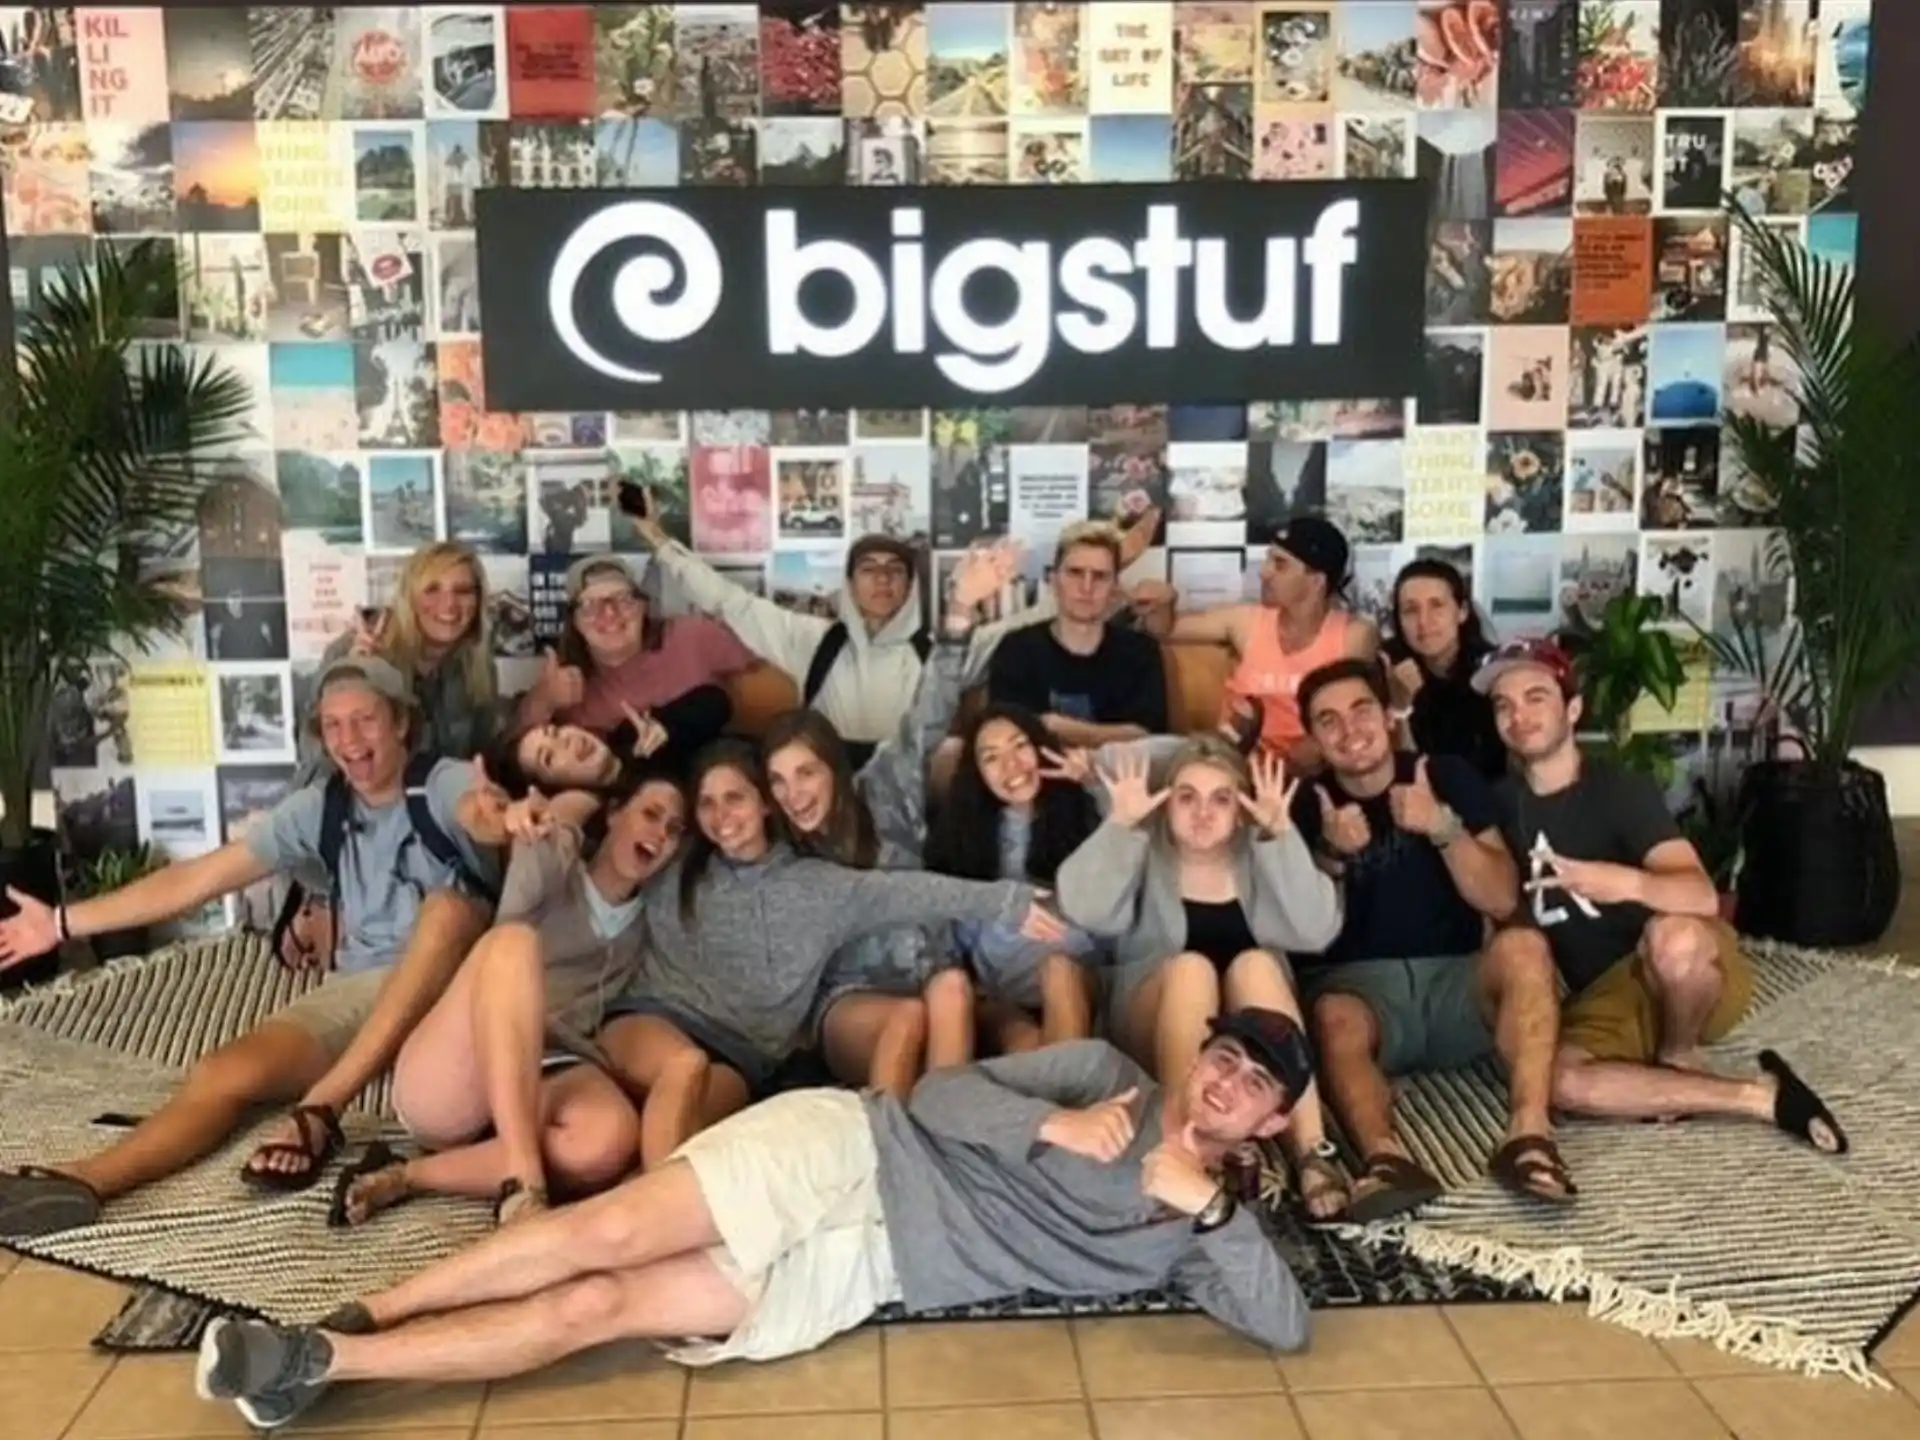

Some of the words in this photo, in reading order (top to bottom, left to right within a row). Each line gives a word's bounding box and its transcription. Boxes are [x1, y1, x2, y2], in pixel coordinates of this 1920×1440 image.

[85, 16, 130, 38] KIL
[87, 43, 110, 64] LI
[88, 67, 129, 92] NG
[90, 94, 117, 117] IT
[764, 199, 1361, 393] bigstuf
